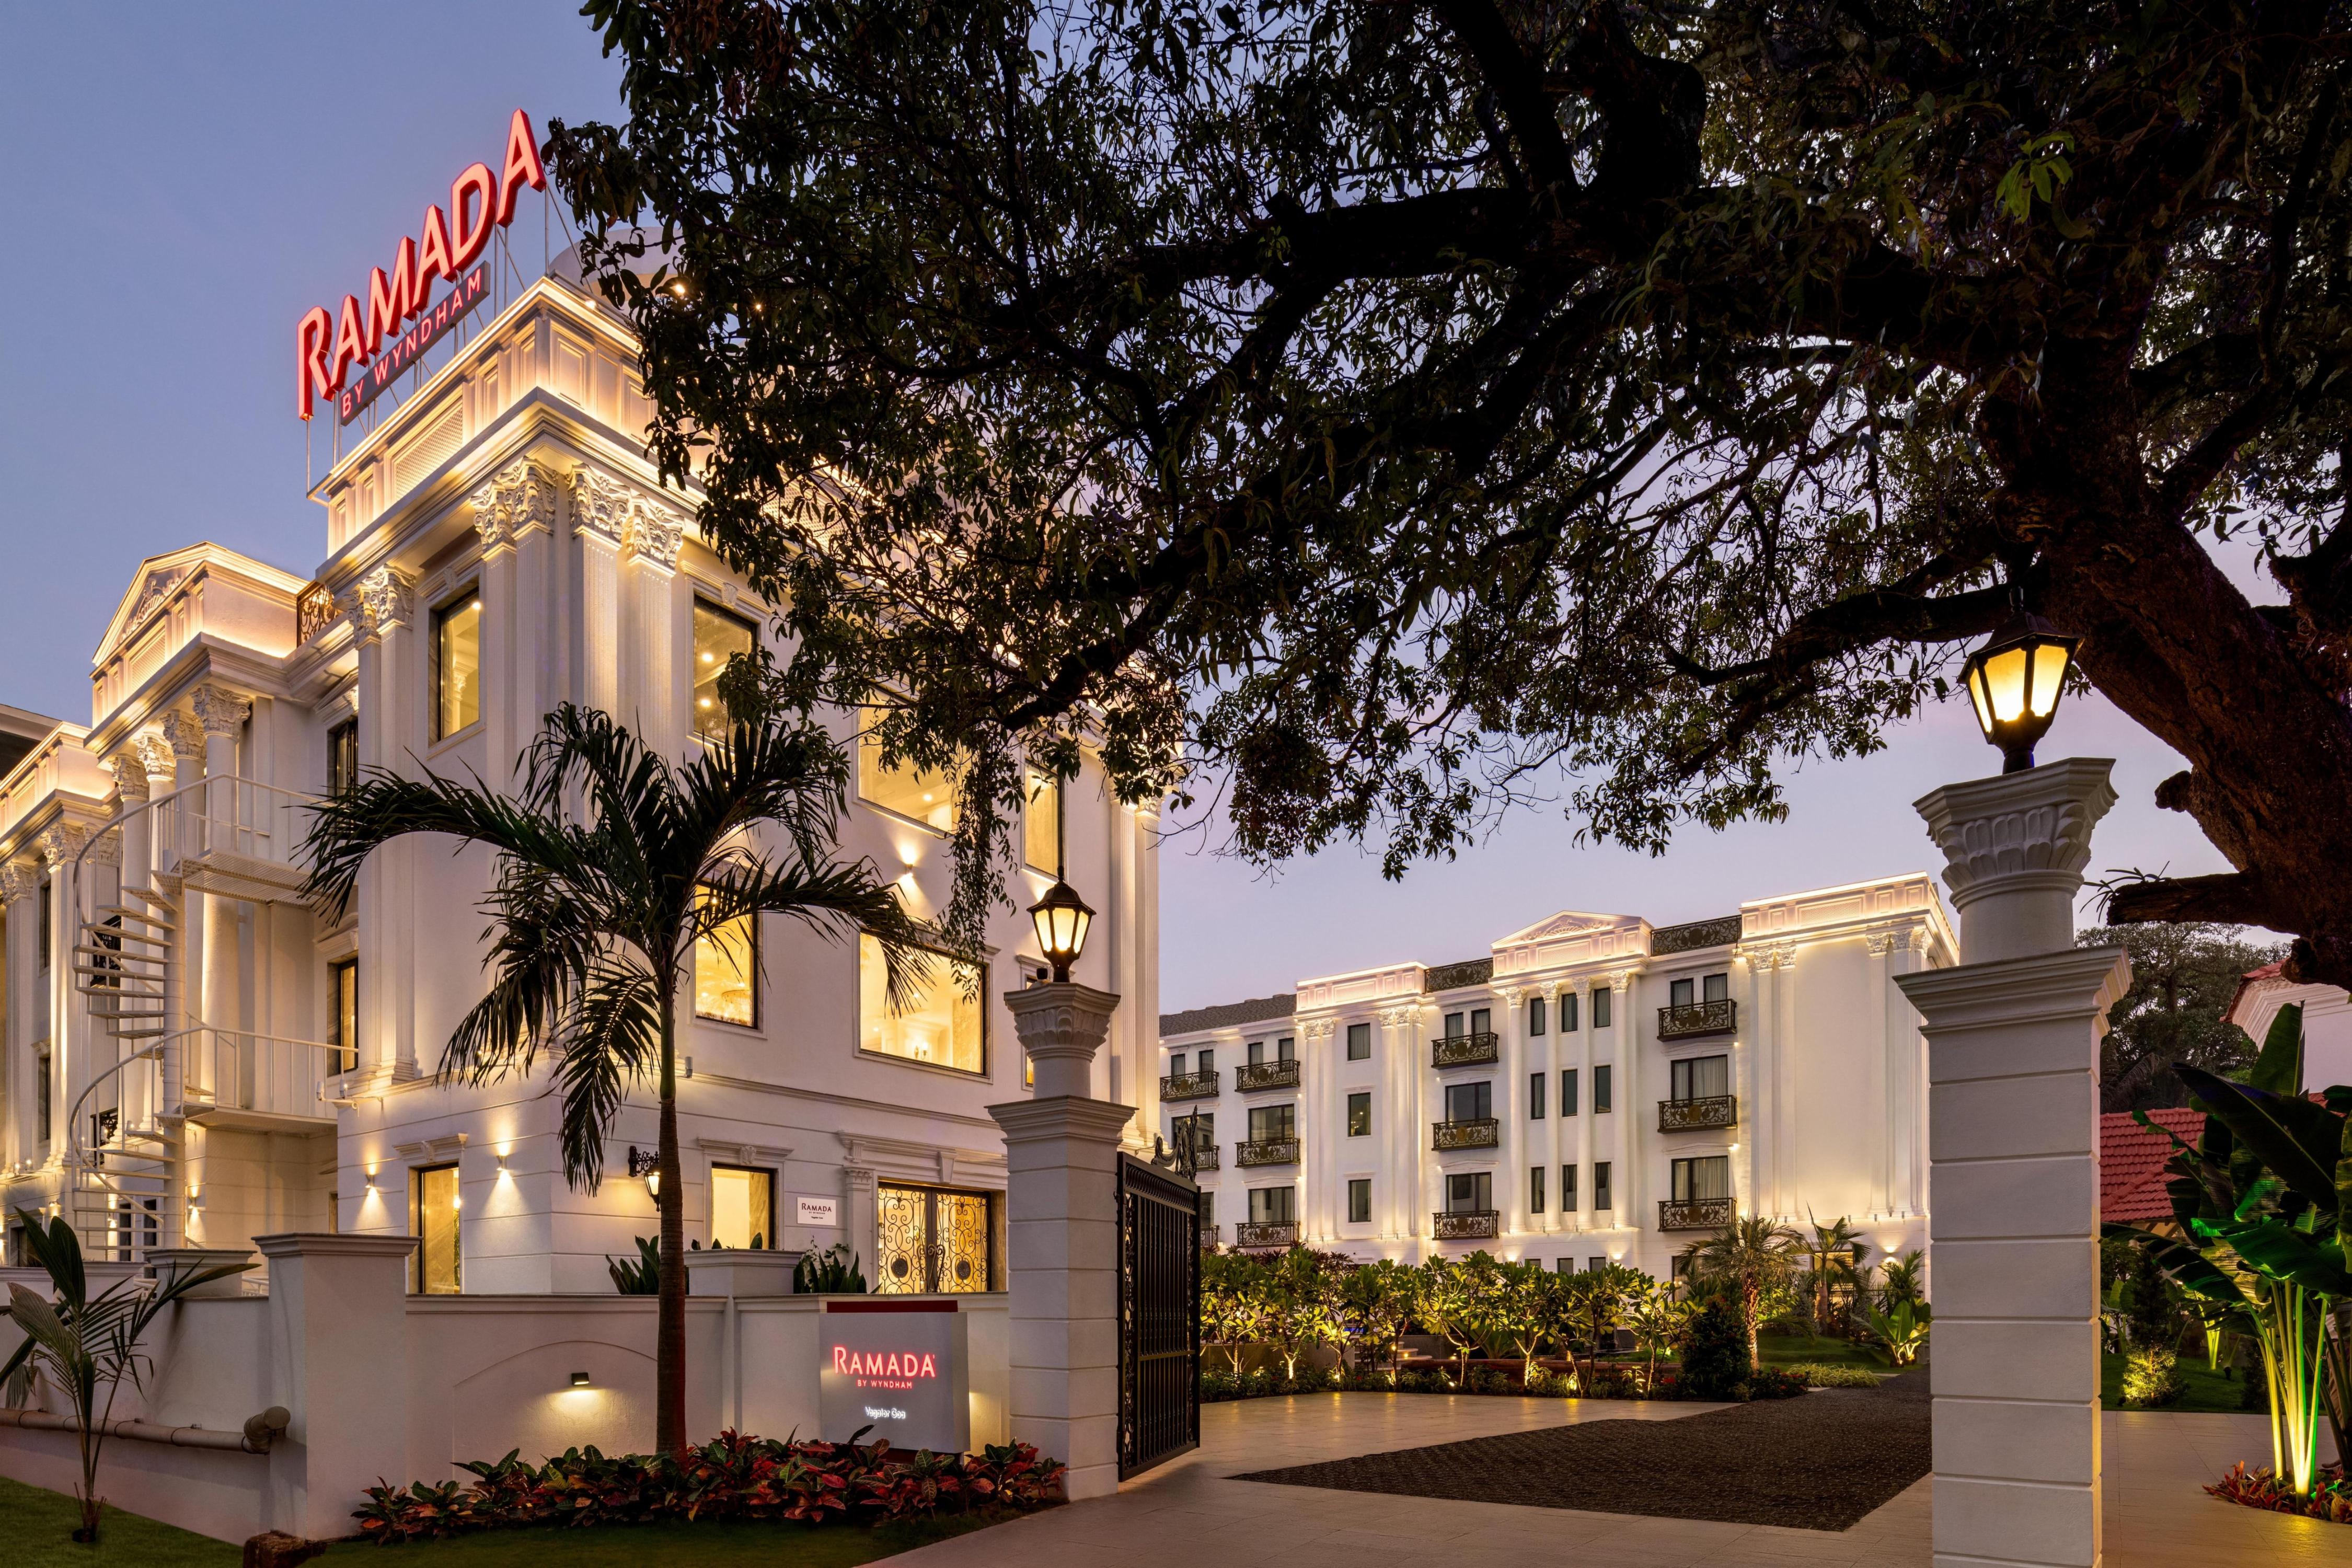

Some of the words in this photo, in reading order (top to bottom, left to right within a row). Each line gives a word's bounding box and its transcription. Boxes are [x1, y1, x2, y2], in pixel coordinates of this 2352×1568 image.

[297, 108, 547, 420] RAMADA
[341, 381, 365, 418] BY
[374, 268, 482, 386] WYNDHAM
[801, 1203, 832, 1212] RAMADA
[834, 1346, 936, 1377] RAMADA
[871, 1380, 912, 1389] WYNDHAM
[865, 1406, 891, 1419] Vagator
[891, 1408, 906, 1419] Goa
